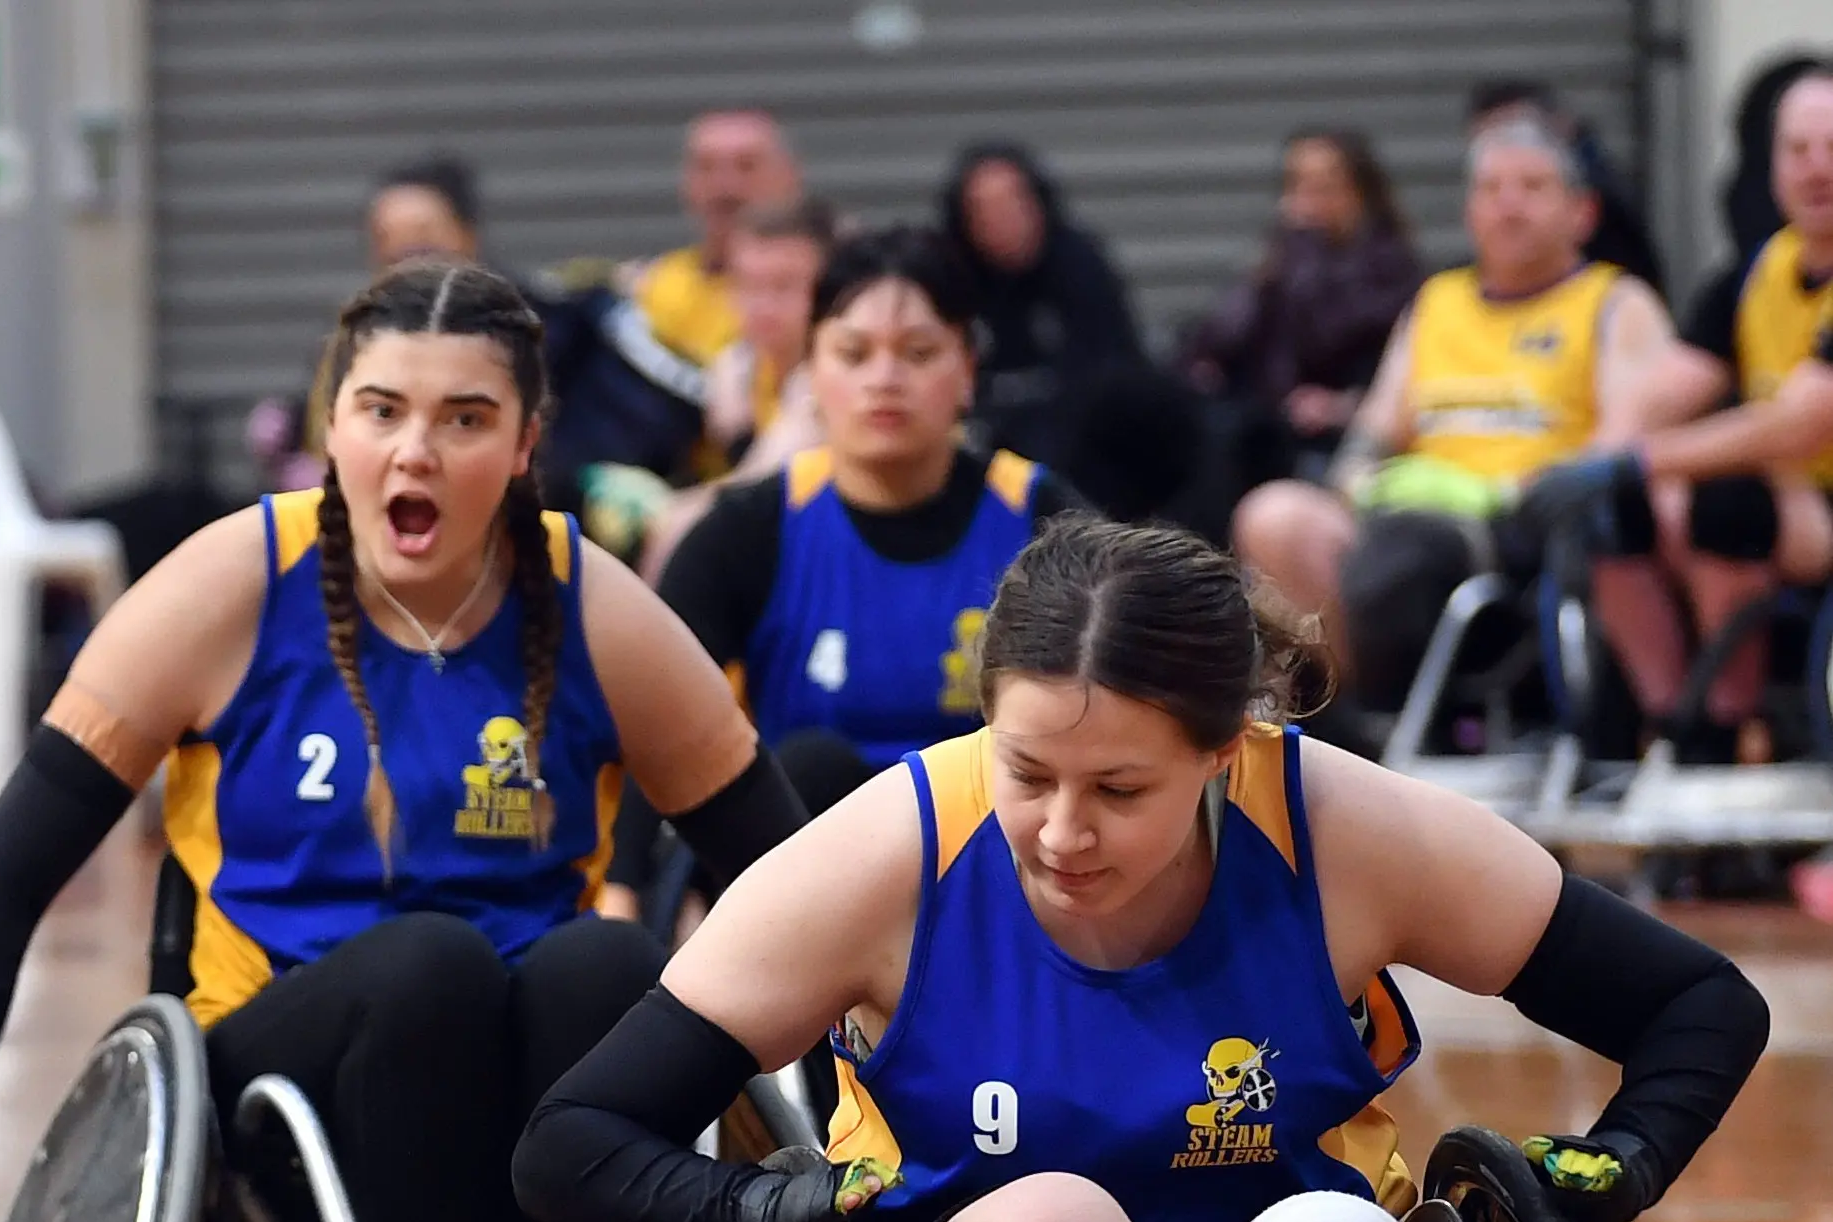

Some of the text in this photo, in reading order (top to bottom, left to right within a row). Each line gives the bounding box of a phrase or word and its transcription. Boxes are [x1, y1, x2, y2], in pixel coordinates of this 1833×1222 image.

[806, 629, 848, 693] 4
[296, 732, 338, 801] 2
[972, 1080, 1019, 1155] 9
[1187, 1123, 1273, 1151] STEAM
[1169, 1148, 1279, 1169] ROLLERS
